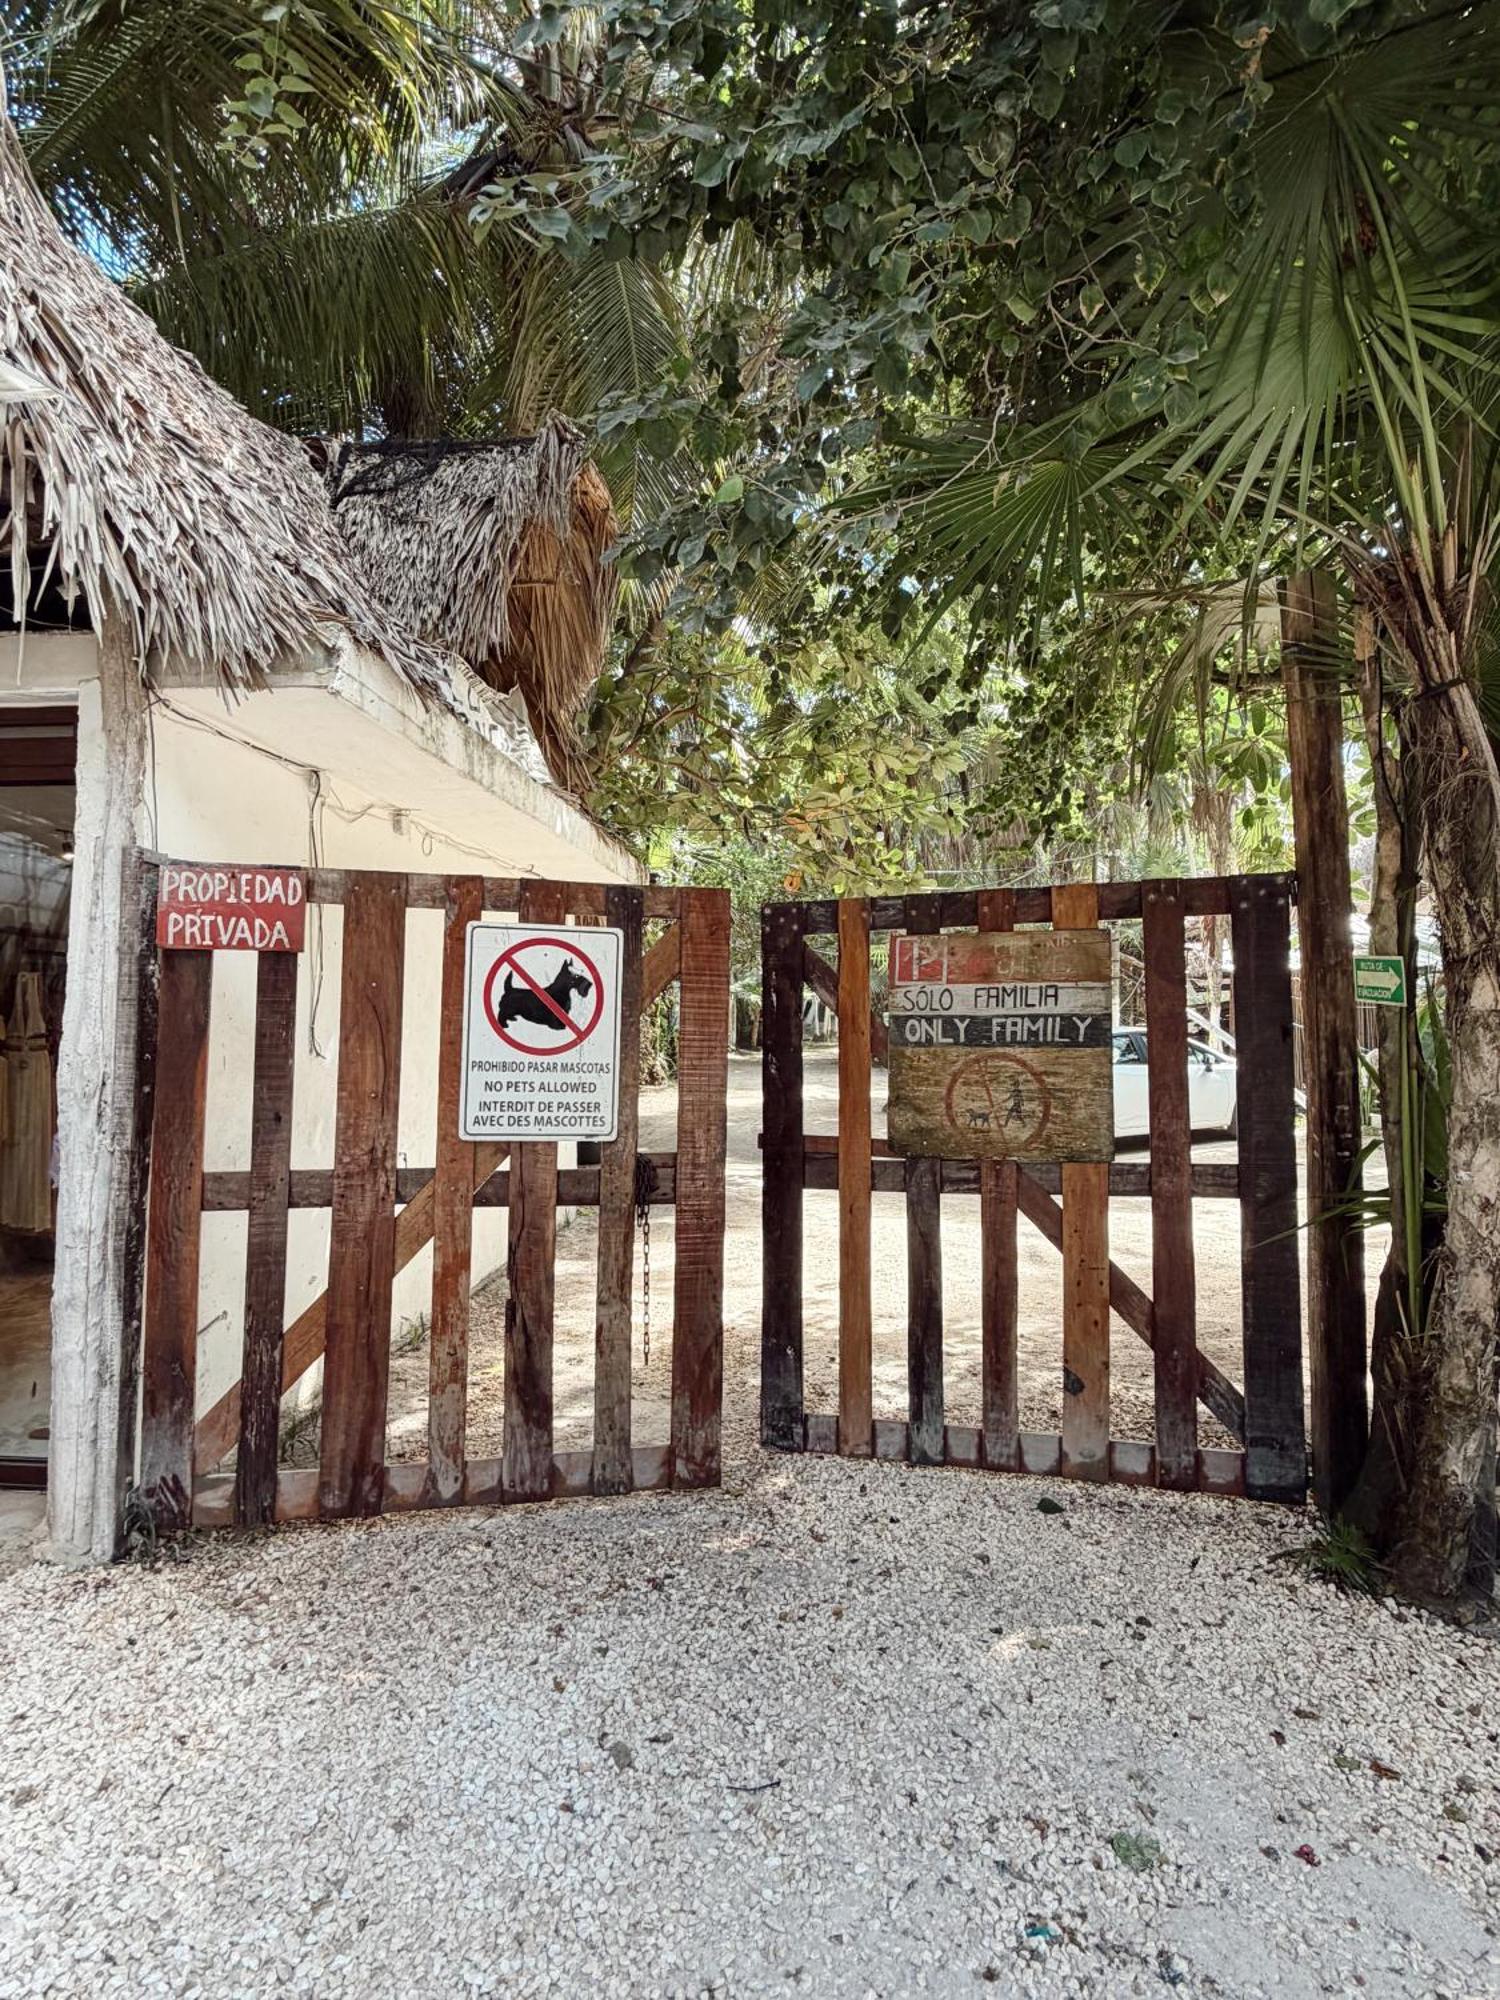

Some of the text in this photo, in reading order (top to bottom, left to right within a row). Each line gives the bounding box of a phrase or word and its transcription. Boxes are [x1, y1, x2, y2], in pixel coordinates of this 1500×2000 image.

[162, 869, 303, 906] PROPIEDAD
[167, 911, 291, 949] PRIVADA
[903, 984, 1059, 1012] SÓLO FAMILIA
[905, 1016, 1093, 1044] ONLY FAMILY
[471, 1060, 611, 1074] PROHIBIDO PASAR MASCOTAS
[484, 1081, 597, 1093] NO PETS ALLOWED
[478, 1101, 601, 1113] INTERDIT DE PASSER
[472, 1115, 606, 1127] AVEC DES MASCOTTES
